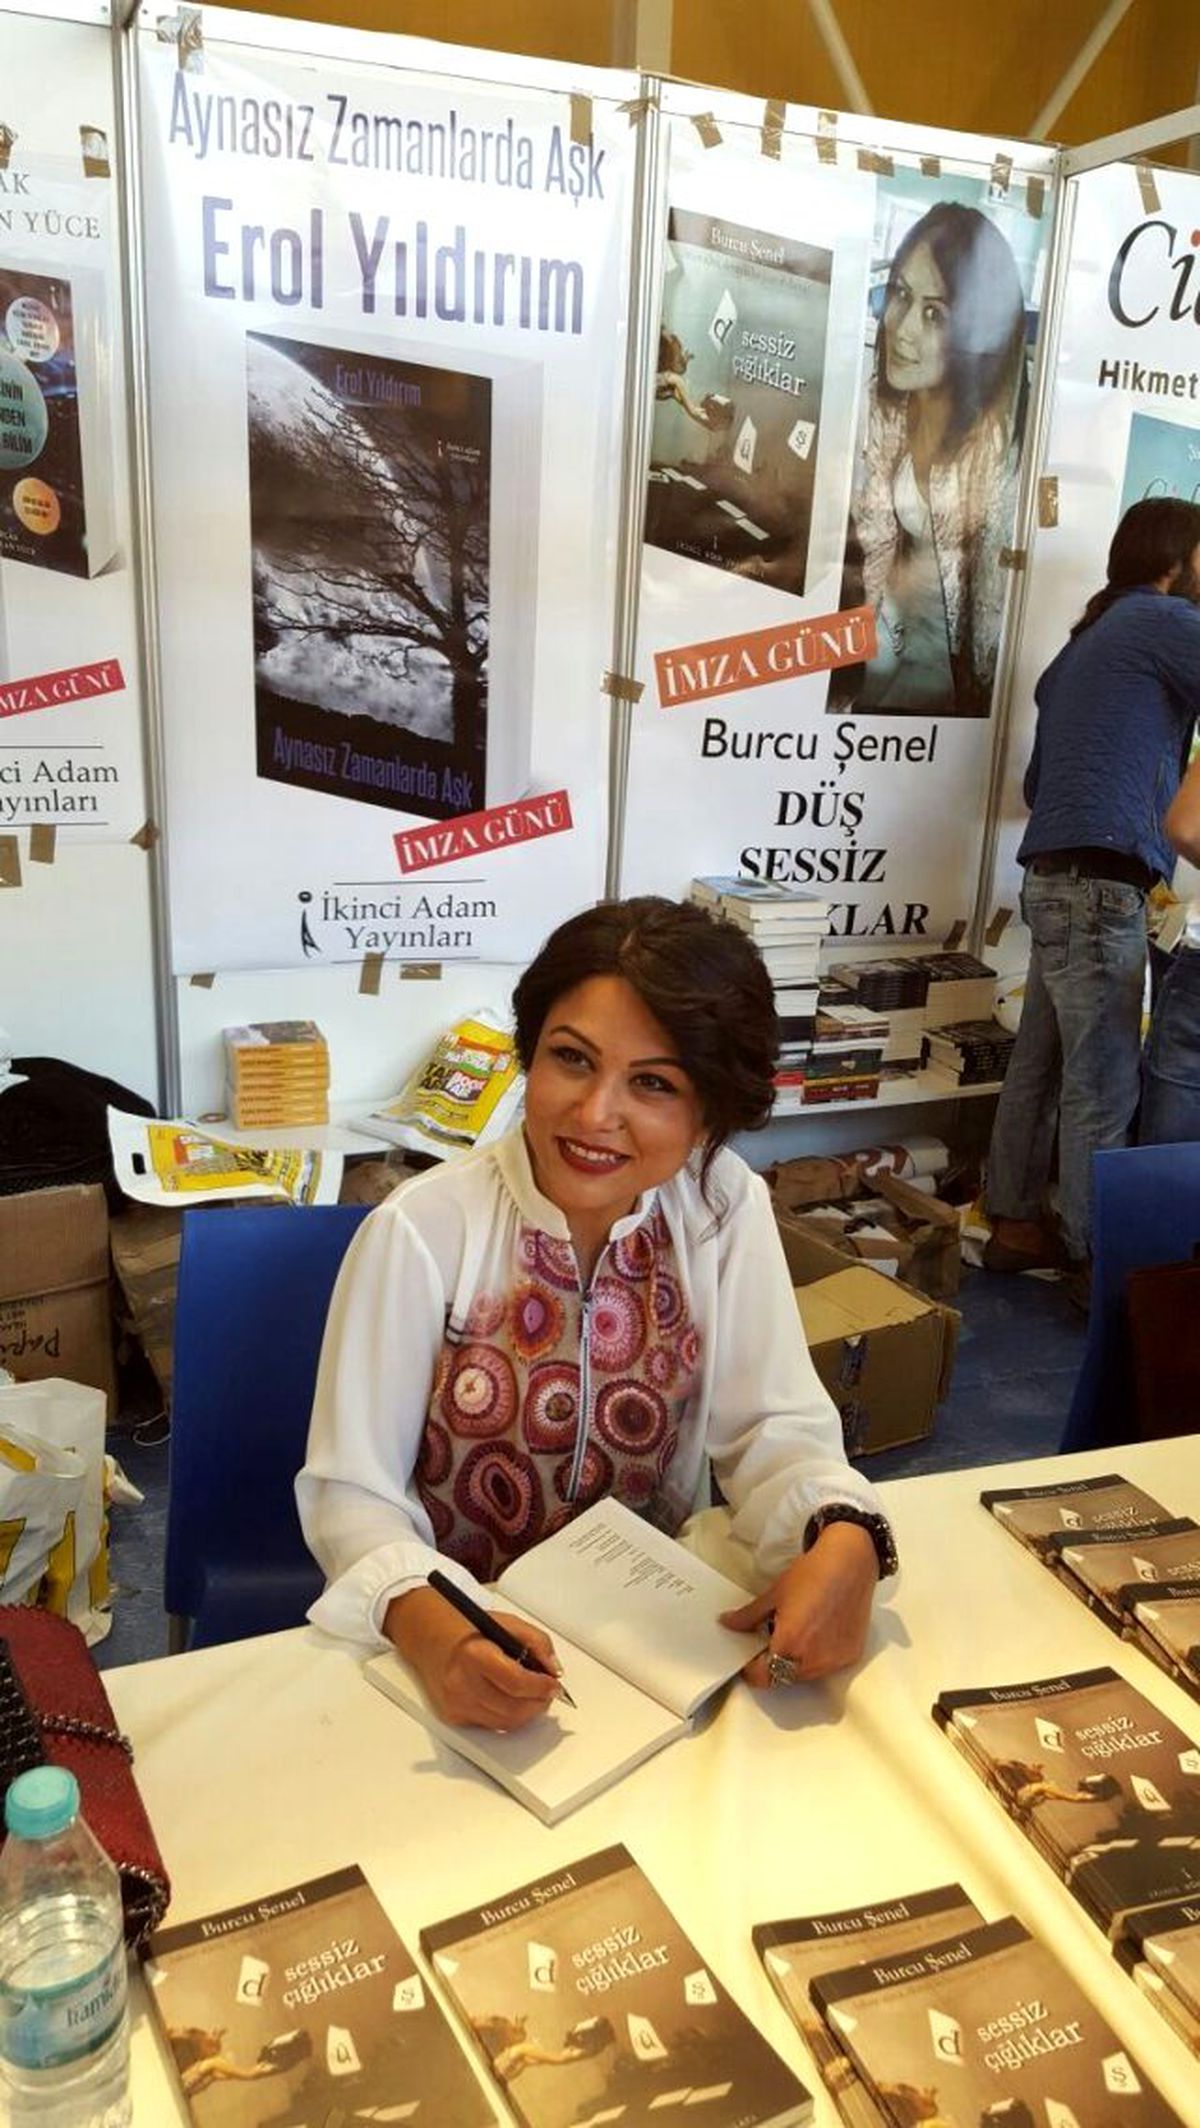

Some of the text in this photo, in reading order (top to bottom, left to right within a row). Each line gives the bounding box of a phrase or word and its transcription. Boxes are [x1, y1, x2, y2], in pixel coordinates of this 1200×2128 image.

[169, 71, 605, 207] Aynasız Zamanlarda Aşk
[23, 208, 101, 240] YÜCE
[711, 227, 748, 254] Burcu
[202, 196, 583, 334] Erol Yıldırım
[1107, 220, 1200, 328] Ci
[741, 330, 796, 360] sessiz
[335, 363, 363, 396] Erol
[1099, 359, 1199, 400] Hikmet
[665, 616, 868, 697] İMZA GÜNÜ
[53, 665, 112, 699] GÜNÜ
[701, 718, 938, 775] Burcu Şenel
[32, 760, 119, 784] Adam
[272, 726, 474, 812] Aynasız Zamanlarda Aşk
[774, 780, 865, 837] DÜŞ
[402, 798, 564, 867] İMZA GÜNÜ
[738, 839, 888, 883] SESSİZ
[322, 891, 497, 921] İkinci Adam
[346, 924, 473, 953] Yayınları
[989, 1680, 1072, 1702] Burcu Şenel
[1075, 1715, 1135, 1742] sessiz
[1081, 1729, 1164, 1759] çığlıklar
[200, 1892, 306, 1938] Burcu Şenel
[480, 1873, 577, 1926] Burcu Şenel
[811, 1902, 910, 1935] Burcu Şenel
[284, 1938, 360, 1981] sessiz
[572, 1924, 642, 1969] sessiz
[872, 1941, 973, 1985] Burcu Şenel
[282, 1953, 387, 2008] çığlıklar
[575, 1944, 670, 1996] çığlıklar
[976, 2000, 1048, 2043] sessiz
[983, 2021, 1085, 2074] çığlıklar
